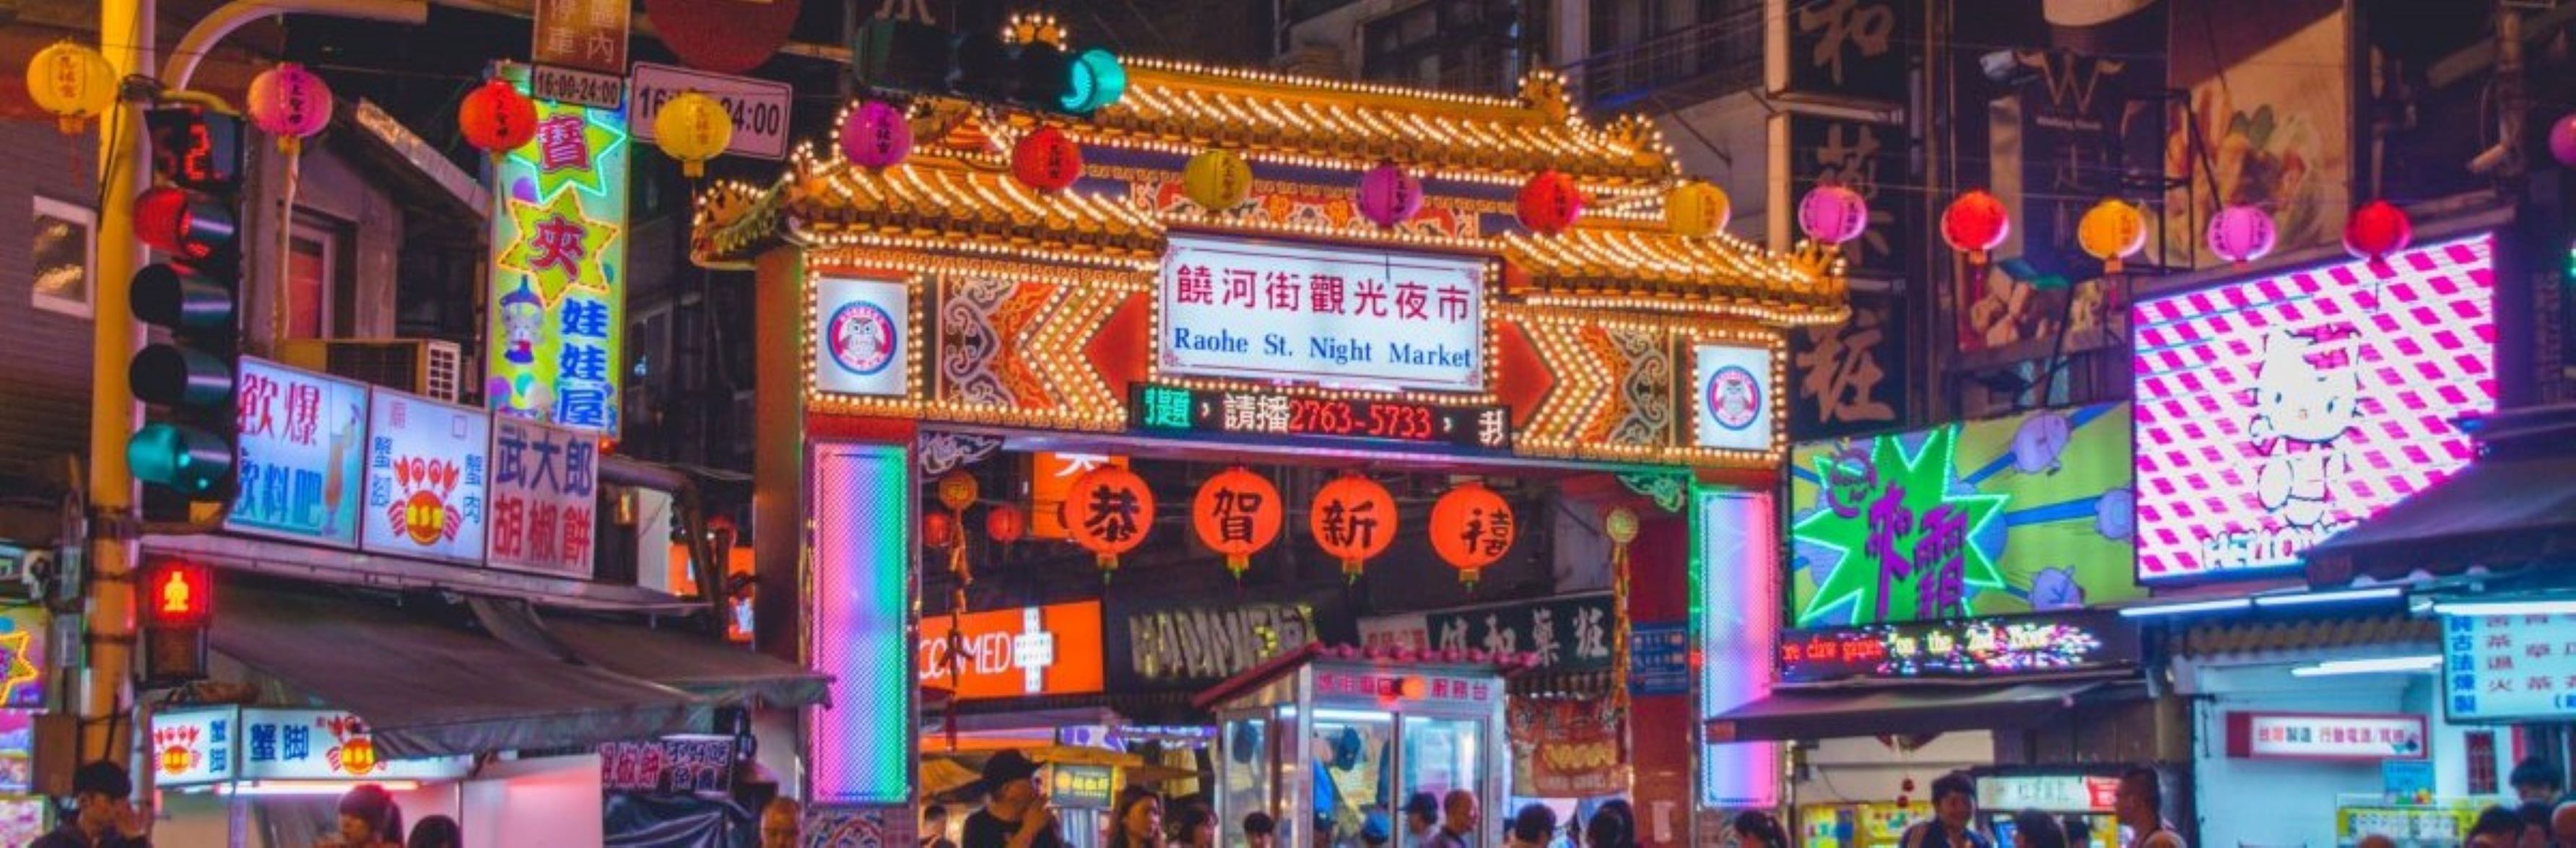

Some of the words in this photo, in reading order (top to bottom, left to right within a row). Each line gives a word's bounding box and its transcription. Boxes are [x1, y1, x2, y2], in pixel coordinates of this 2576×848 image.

[537, 71, 619, 105] 16:00-24:00
[1176, 264, 1470, 323] 饒河街觀光夜市
[559, 297, 610, 427] 娃娃屋
[1174, 327, 1249, 354] Raohe
[1263, 335, 1293, 358] St.
[1309, 337, 1372, 364] Night
[1389, 343, 1472, 369] Market
[495, 427, 593, 499] 武大郎
[492, 494, 591, 567] 胡椒餅
